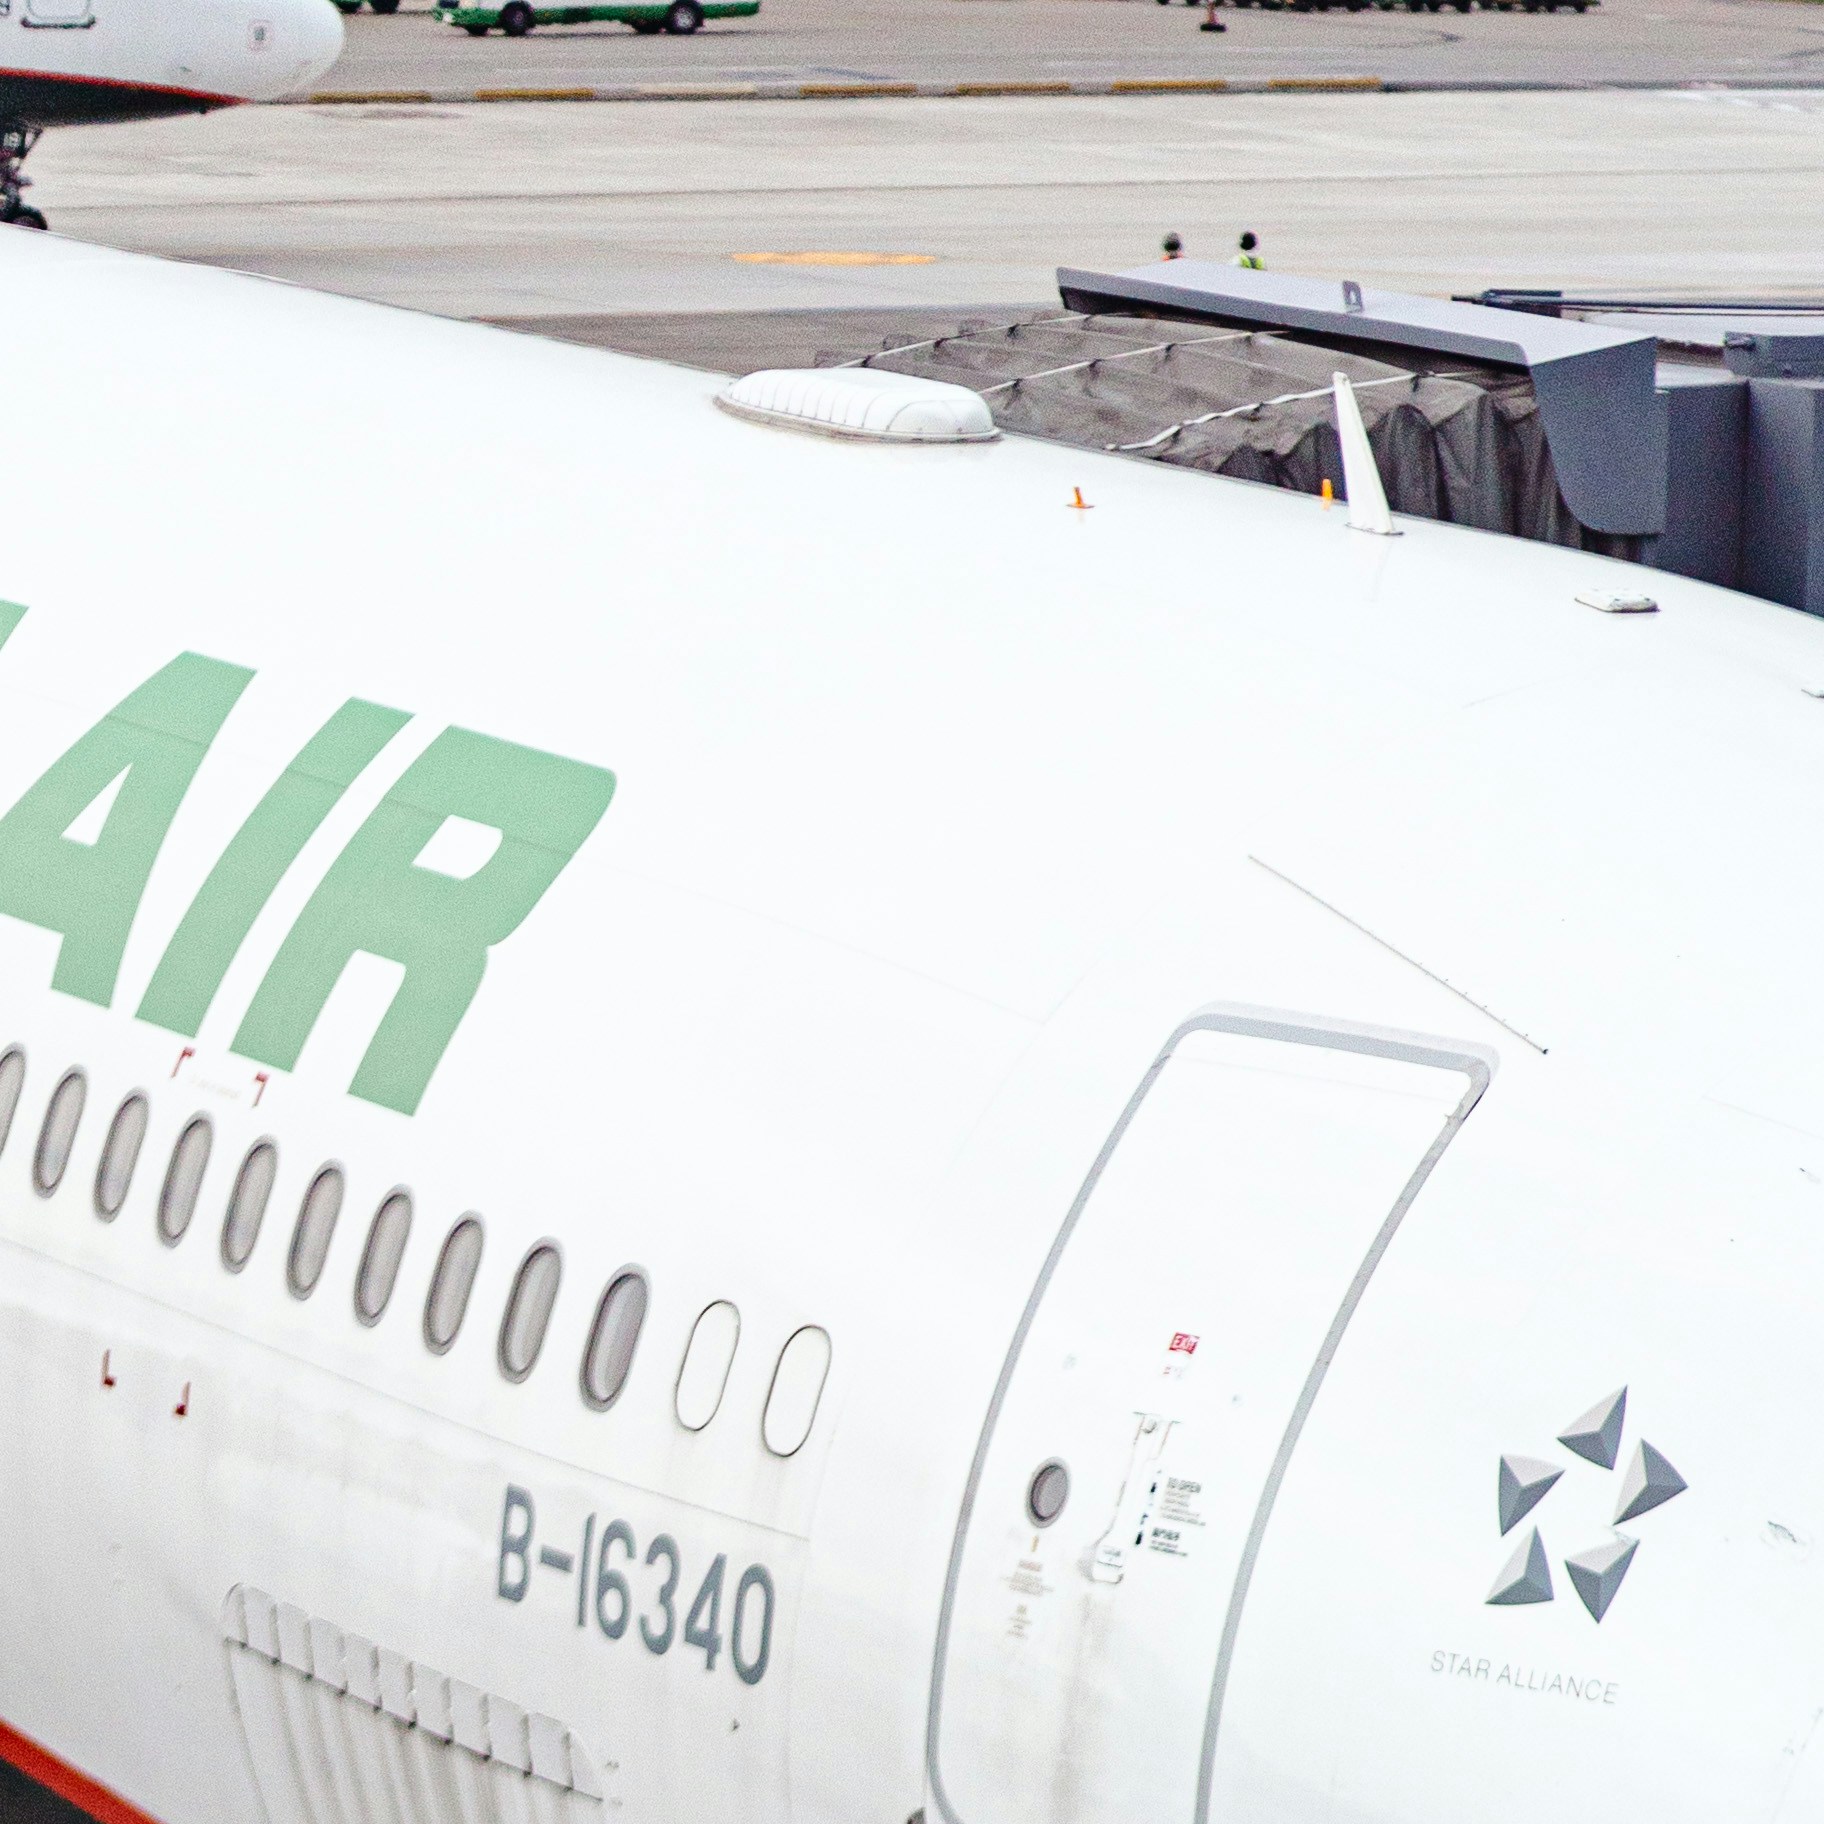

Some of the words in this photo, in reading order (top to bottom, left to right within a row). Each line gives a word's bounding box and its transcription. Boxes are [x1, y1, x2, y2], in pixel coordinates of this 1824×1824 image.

[0, 650, 617, 1118] AIR
[497, 1482, 776, 1685] B-16340
[1431, 1650, 1491, 1679] STAR
[1496, 1664, 1619, 1704] ALLIANCE
